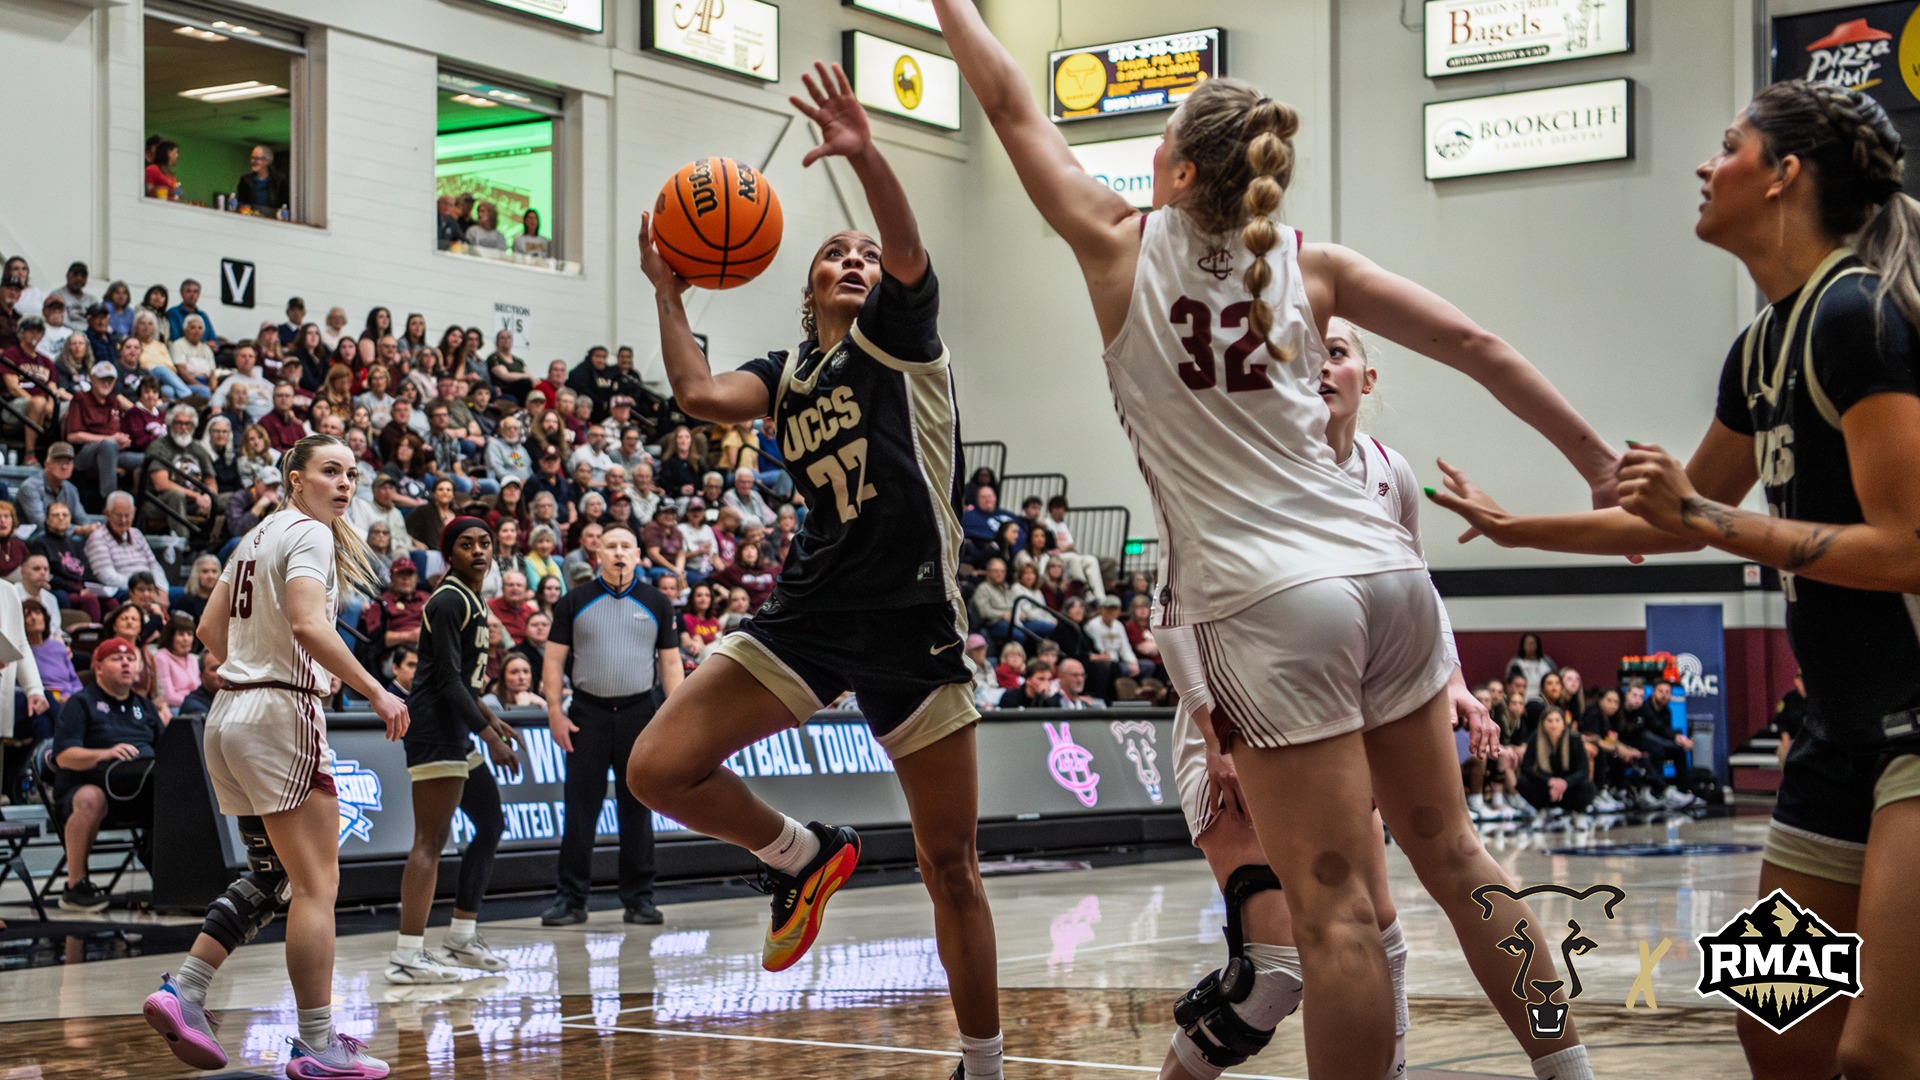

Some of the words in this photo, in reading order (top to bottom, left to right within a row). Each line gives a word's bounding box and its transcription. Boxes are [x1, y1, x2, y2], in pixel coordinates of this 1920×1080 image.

[1449, 9, 1541, 46] Bagels
[1103, 96, 1131, 112] BUD
[1131, 92, 1165, 109] LIGHT
[1480, 105, 1623, 139] BOOKCLIFF
[223, 261, 254, 304] V
[494, 302, 531, 317] SECTION
[1169, 295, 1274, 393] 32
[783, 384, 862, 462] UCCS
[230, 560, 257, 619] 15
[722, 726, 813, 778] ETBALL
[807, 723, 895, 774] TOURN
[451, 801, 555, 844] PRENTED
